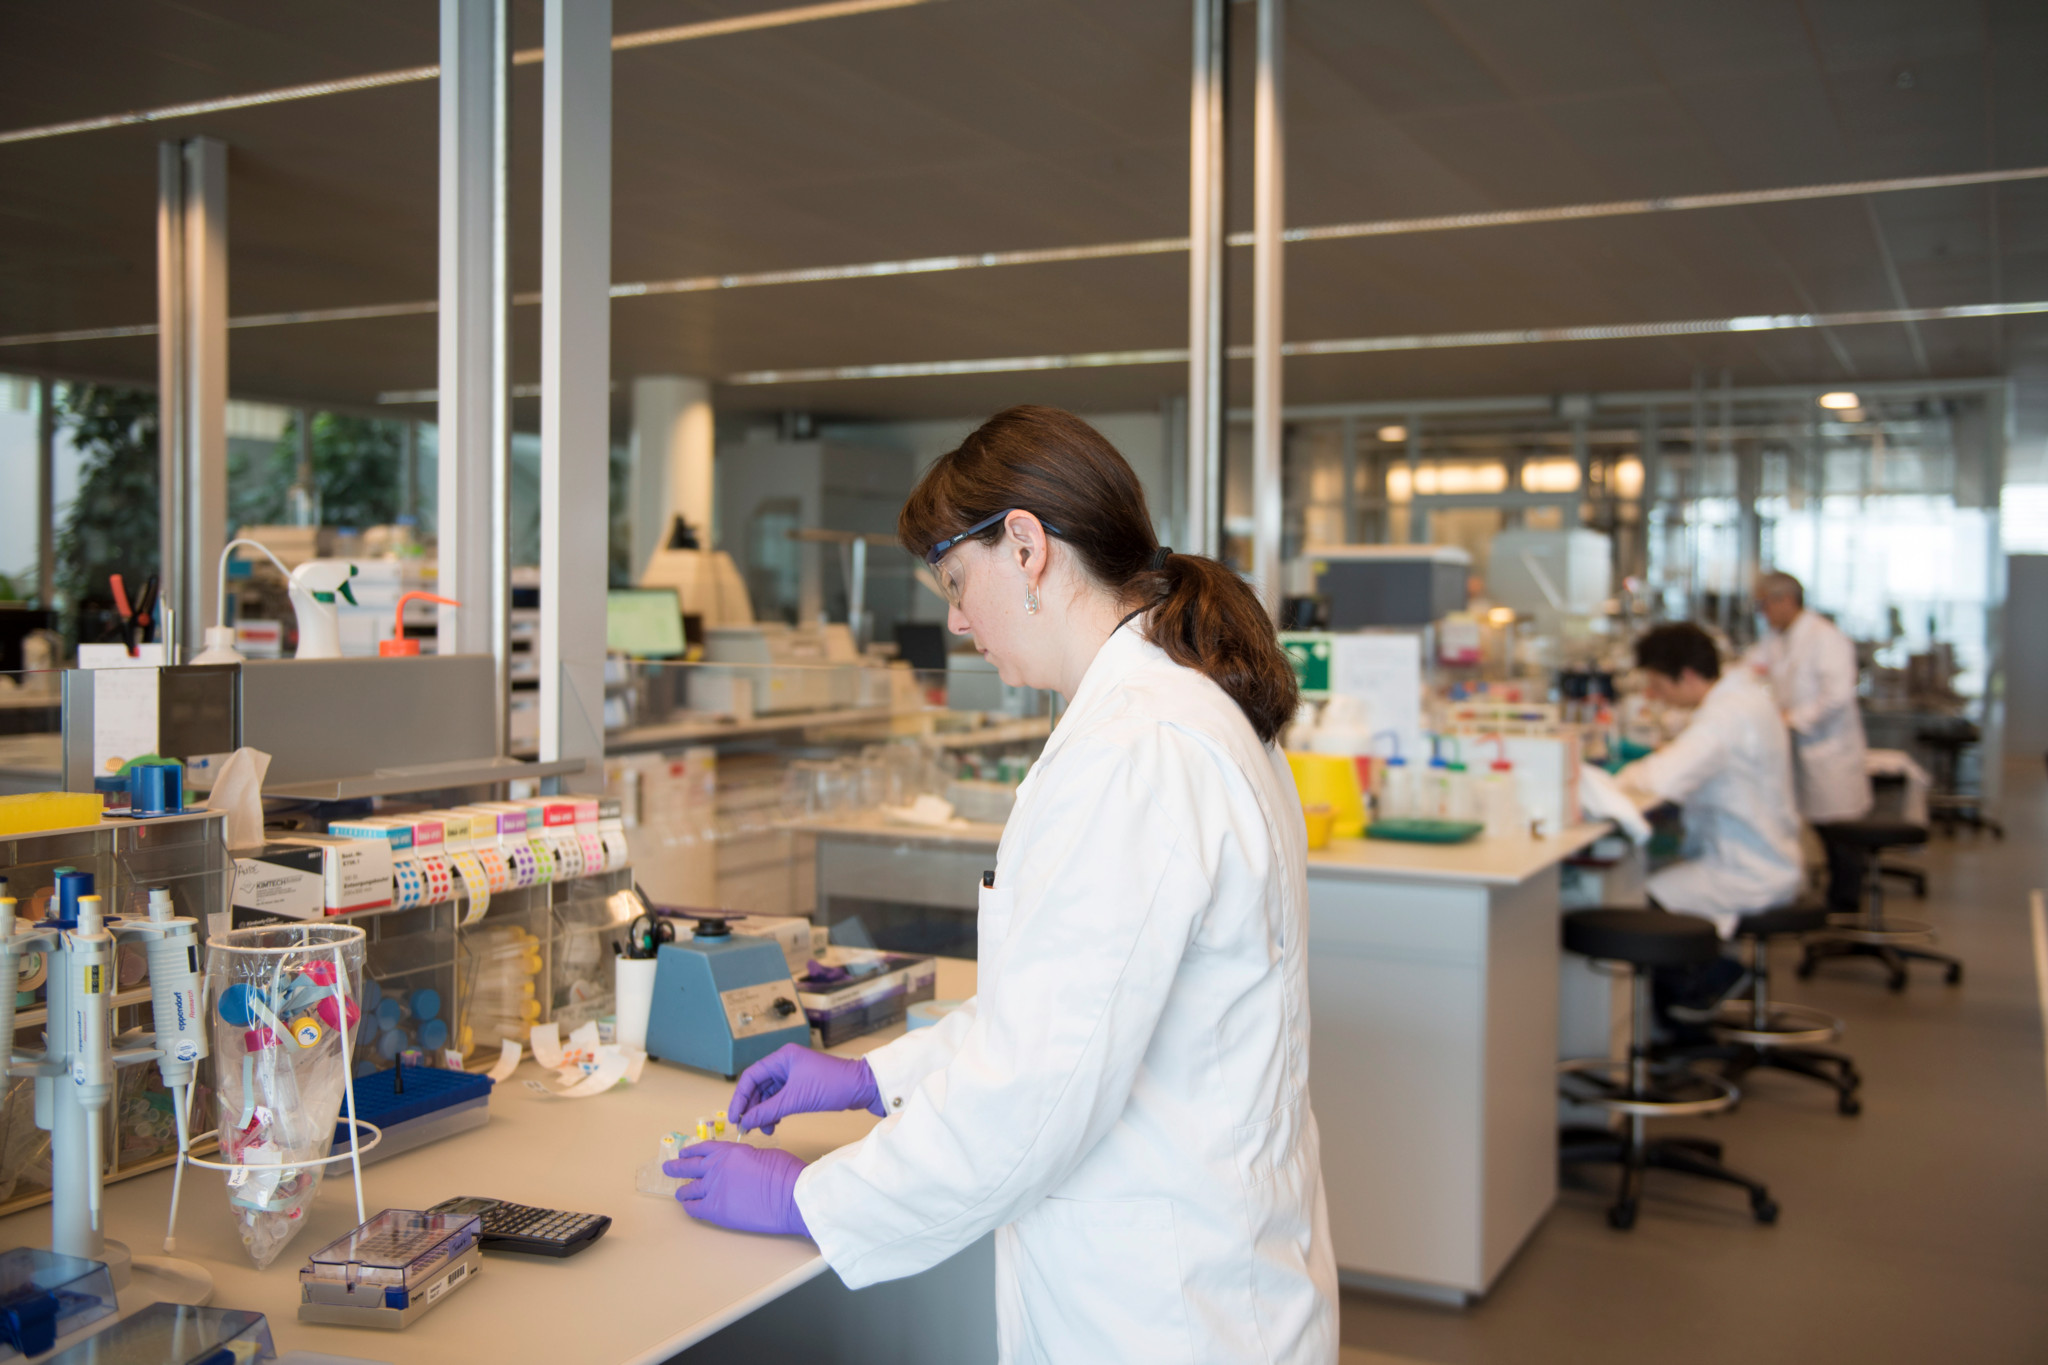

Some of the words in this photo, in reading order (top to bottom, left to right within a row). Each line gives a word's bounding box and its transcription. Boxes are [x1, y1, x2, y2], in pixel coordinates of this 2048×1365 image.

[256, 878, 286, 889] KIMTECH
[173, 992, 187, 1031] eppendorf
[187, 989, 195, 1018] Research
